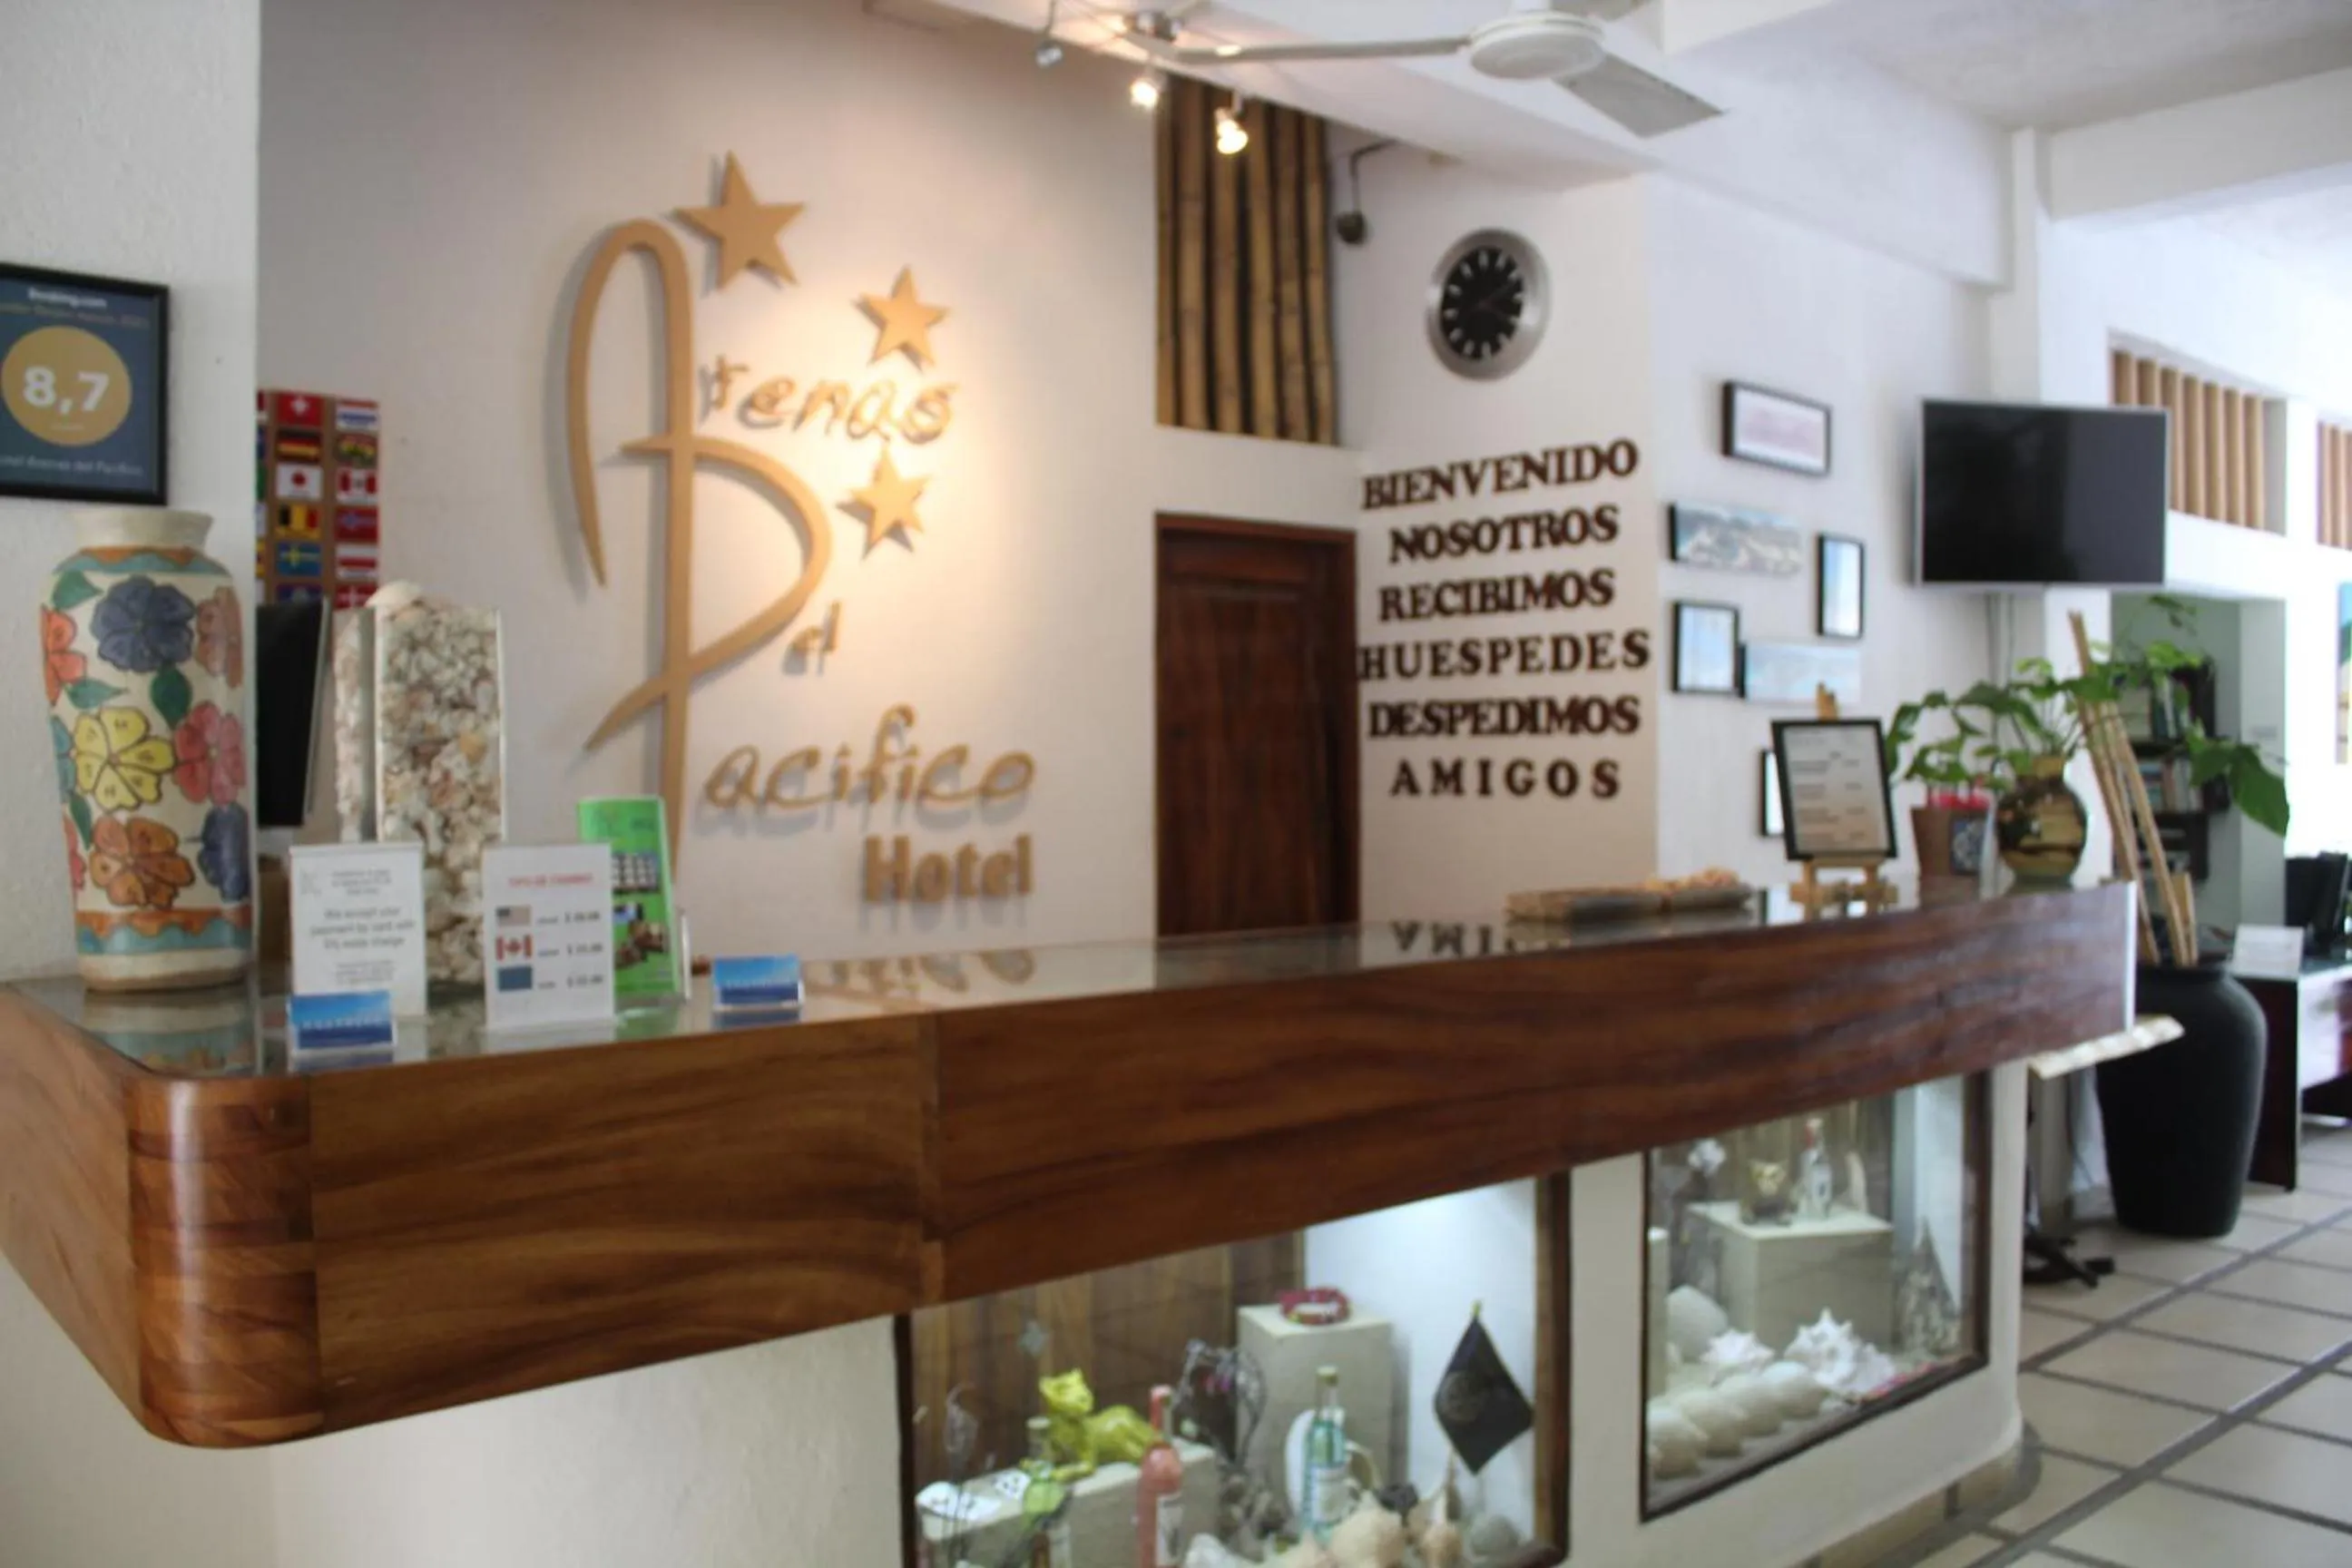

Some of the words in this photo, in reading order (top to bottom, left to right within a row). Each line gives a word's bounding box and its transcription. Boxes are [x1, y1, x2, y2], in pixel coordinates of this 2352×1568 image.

[23, 366, 110, 416] 8,7
[1361, 437, 1639, 511] BIENVENIDO
[1388, 503, 1621, 564] NOSOTROS
[1378, 567, 1616, 622] RECIBIMOS
[1357, 630, 1651, 681] HUESPEDES
[1367, 694, 1641, 739] DESPEDIMOS
[1389, 758, 1621, 799] AMIGOS
[863, 832, 1034, 904] Hotel
